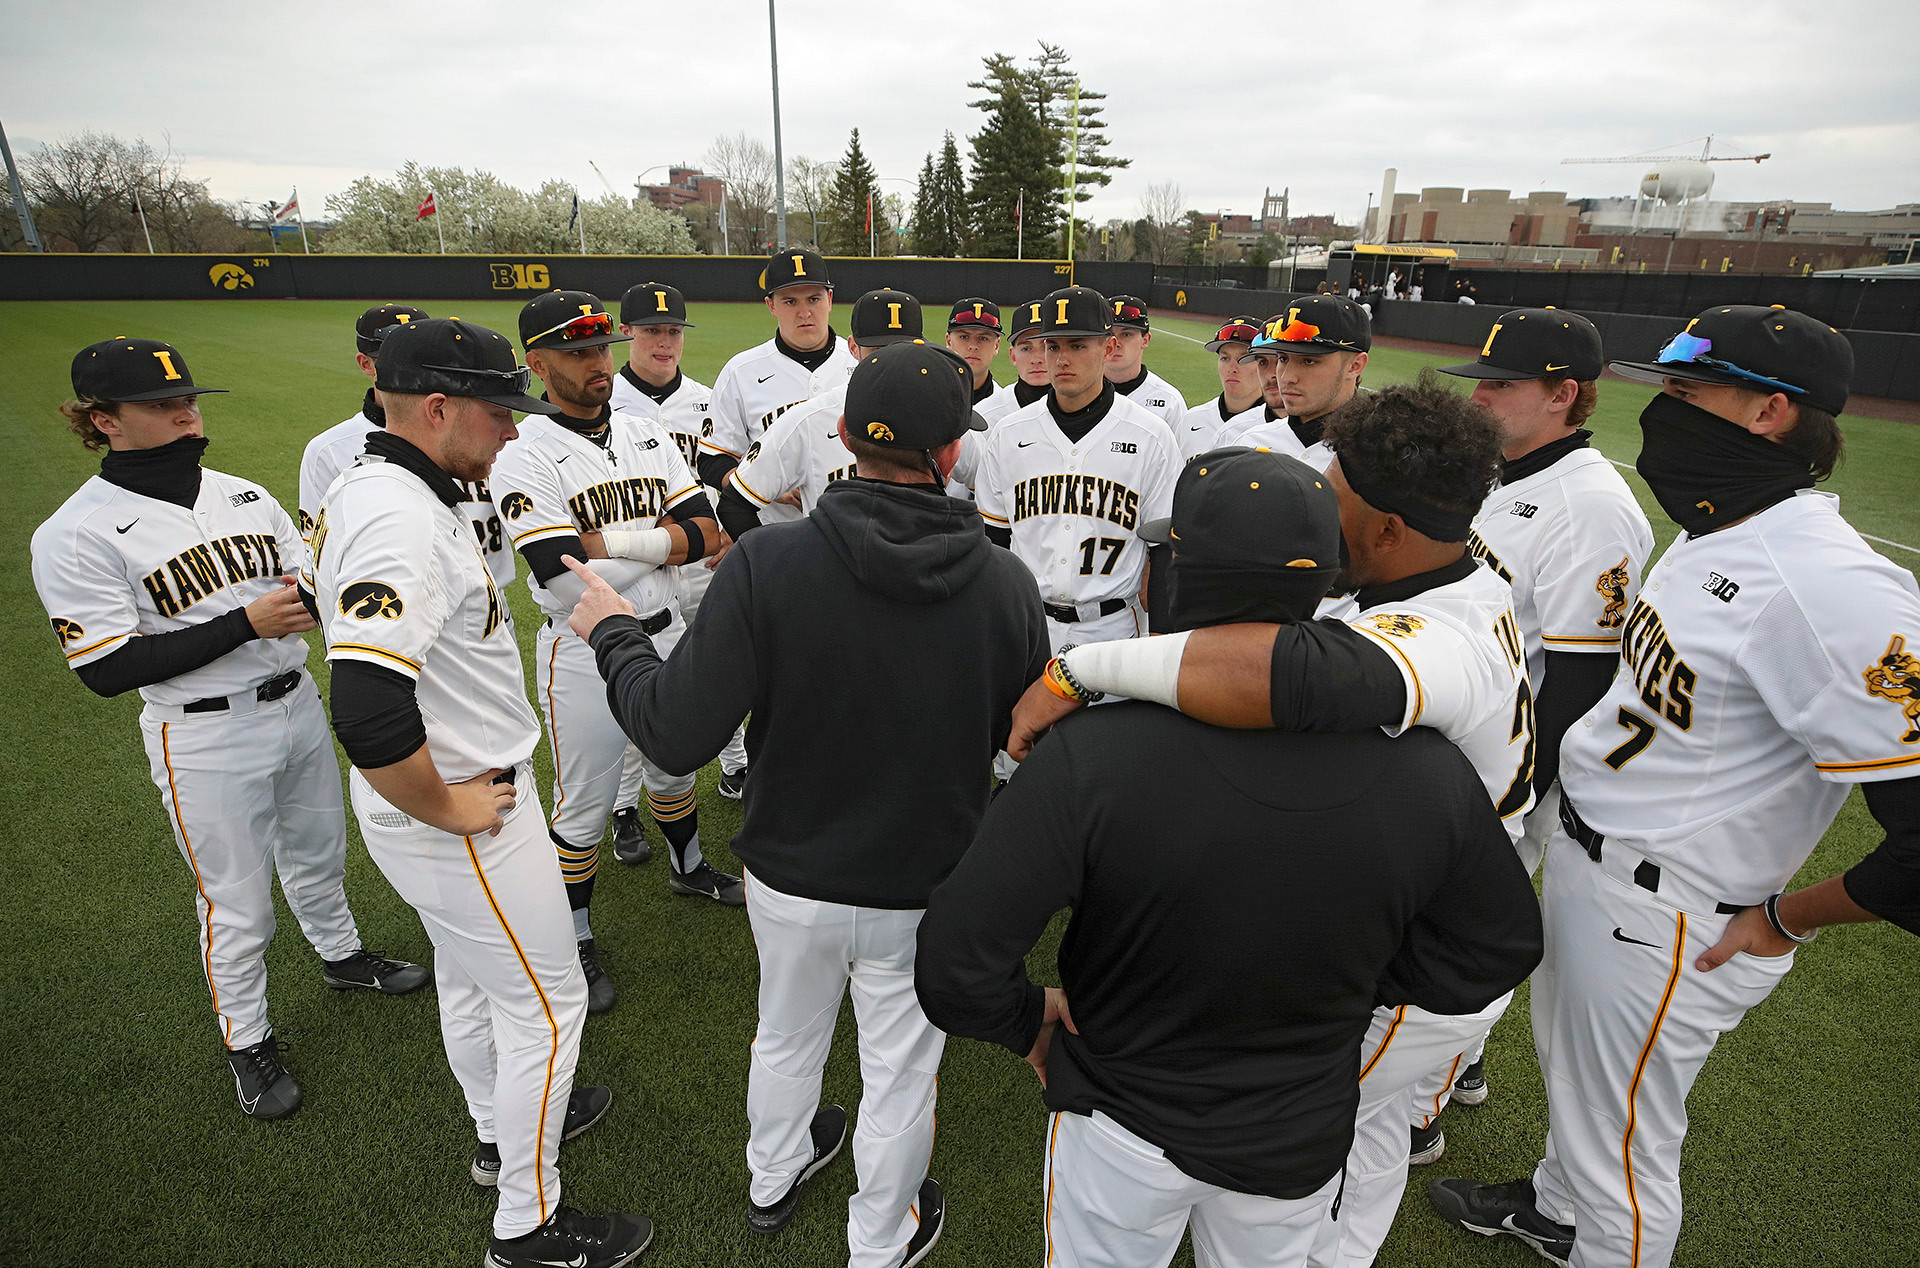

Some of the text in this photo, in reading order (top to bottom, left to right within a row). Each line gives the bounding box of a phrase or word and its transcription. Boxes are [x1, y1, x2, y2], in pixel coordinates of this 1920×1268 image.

[791, 255, 807, 276] I
[1054, 265, 1071, 274] 327
[654, 291, 669, 312] I
[887, 303, 902, 329] I
[1055, 299, 1069, 325] I
[1482, 324, 1503, 356] I
[153, 351, 182, 381] I
[568, 477, 668, 533] HAWKEYE
[1014, 474, 1139, 531] HAWKEYES
[1079, 536, 1127, 576] 17
[142, 534, 283, 618] HAWKEYE
[1602, 704, 1657, 772] 7
